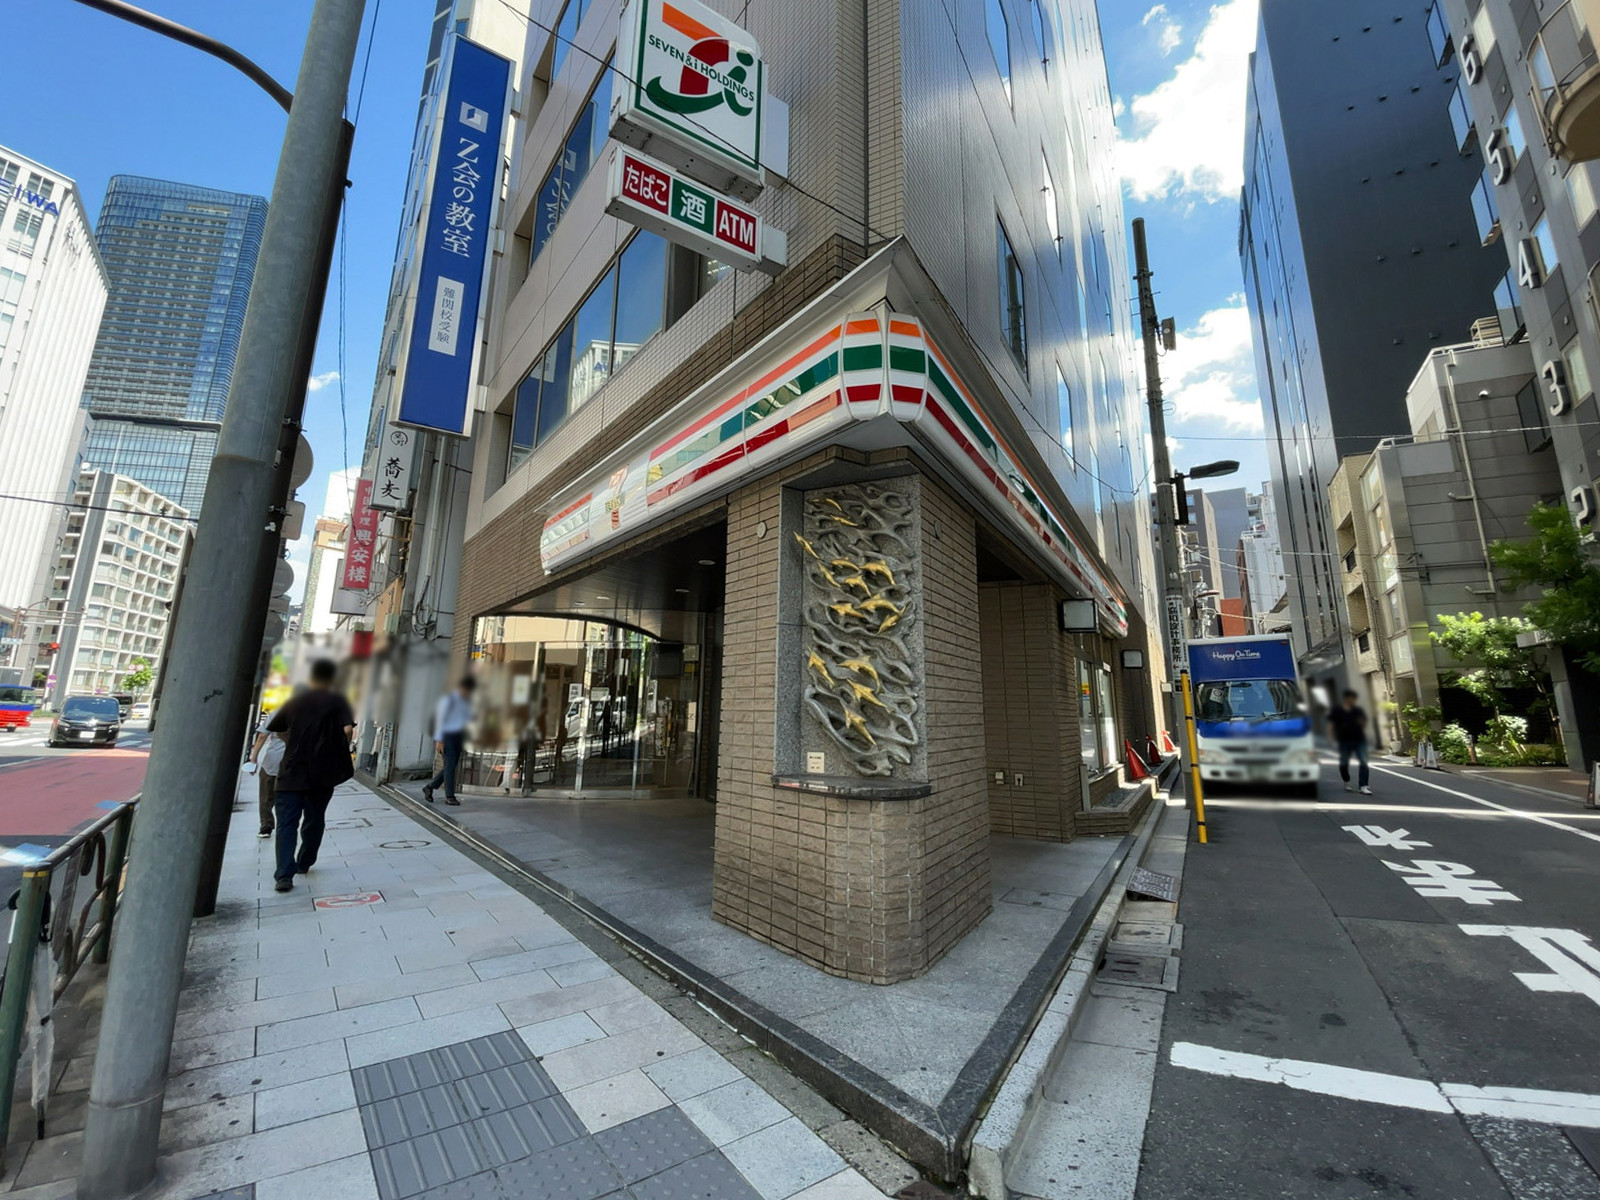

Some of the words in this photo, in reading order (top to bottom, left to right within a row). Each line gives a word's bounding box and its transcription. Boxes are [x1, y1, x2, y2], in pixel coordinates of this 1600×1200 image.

[648, 34, 698, 71] SEVEN&i
[700, 65, 755, 102] HOLDINGS
[1460, 34, 1481, 86] 6
[1485, 130, 1507, 186] 5
[441, 137, 481, 258] Z会の教室
[624, 165, 668, 206] たばこ
[679, 189, 707, 225] 酒
[718, 209, 754, 247] ATM
[1518, 238, 1537, 290] 4
[436, 286, 456, 344] 難関校受験
[1542, 360, 1564, 417] 3
[380, 457, 405, 501] 蕎麦
[1212, 651, 1235, 661] Happy
[1244, 649, 1260, 657] Time
